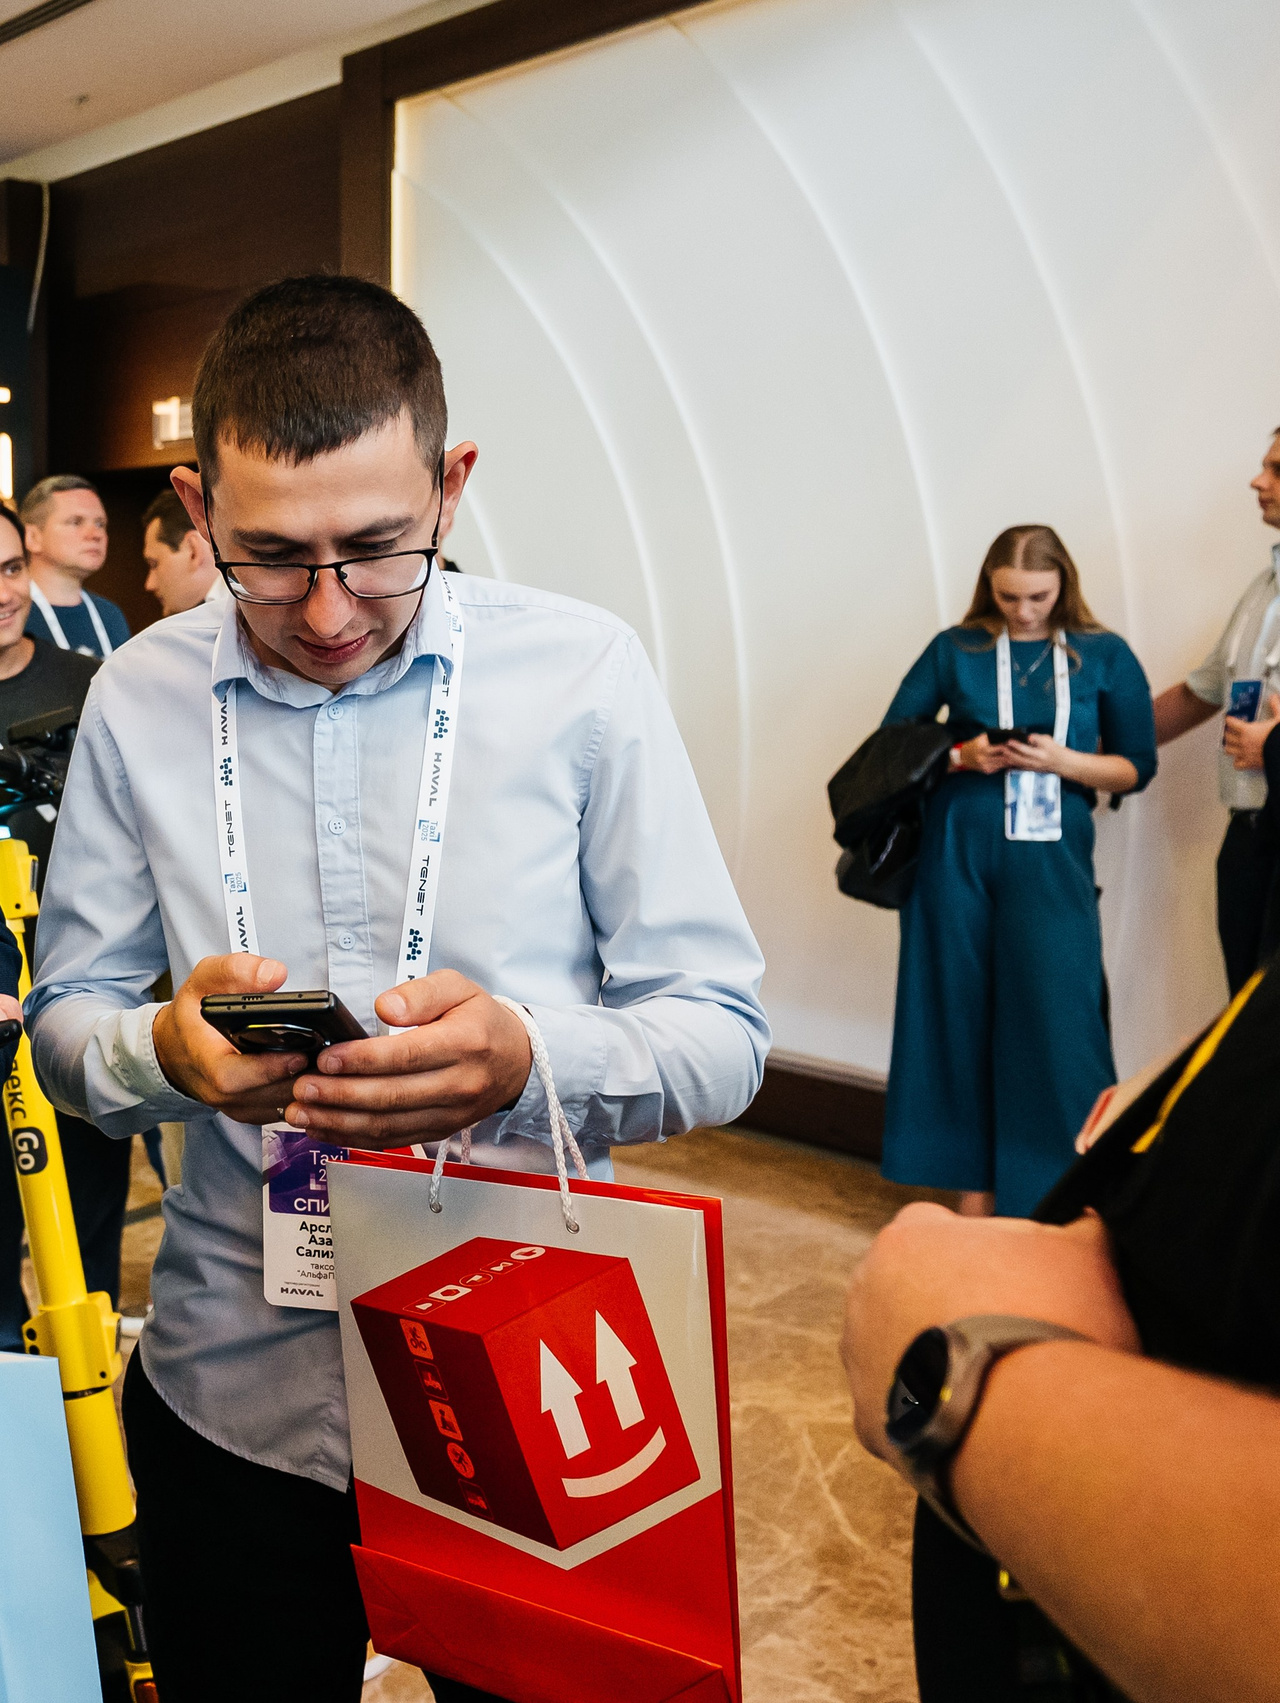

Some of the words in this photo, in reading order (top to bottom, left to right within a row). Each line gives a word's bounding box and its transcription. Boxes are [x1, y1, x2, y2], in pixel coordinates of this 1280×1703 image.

[429, 752, 442, 806] HAVAL
[224, 800, 235, 857] TENET
[421, 824, 429, 841] 2025
[429, 821, 438, 838] Taxi
[235, 872, 243, 888] 2025
[416, 855, 429, 916] TENET
[236, 906, 249, 953] AVAL
[6, 1059, 27, 1121] екс
[14, 1132, 39, 1170] Go
[293, 1198, 330, 1212] СПИ
[299, 1221, 332, 1235] Арсл
[308, 1234, 333, 1246] Аза
[295, 1246, 334, 1259] Сали
[297, 1270, 335, 1280] "АльфаП
[310, 1263, 335, 1271] таксо
[280, 1287, 324, 1297] HAVAL
